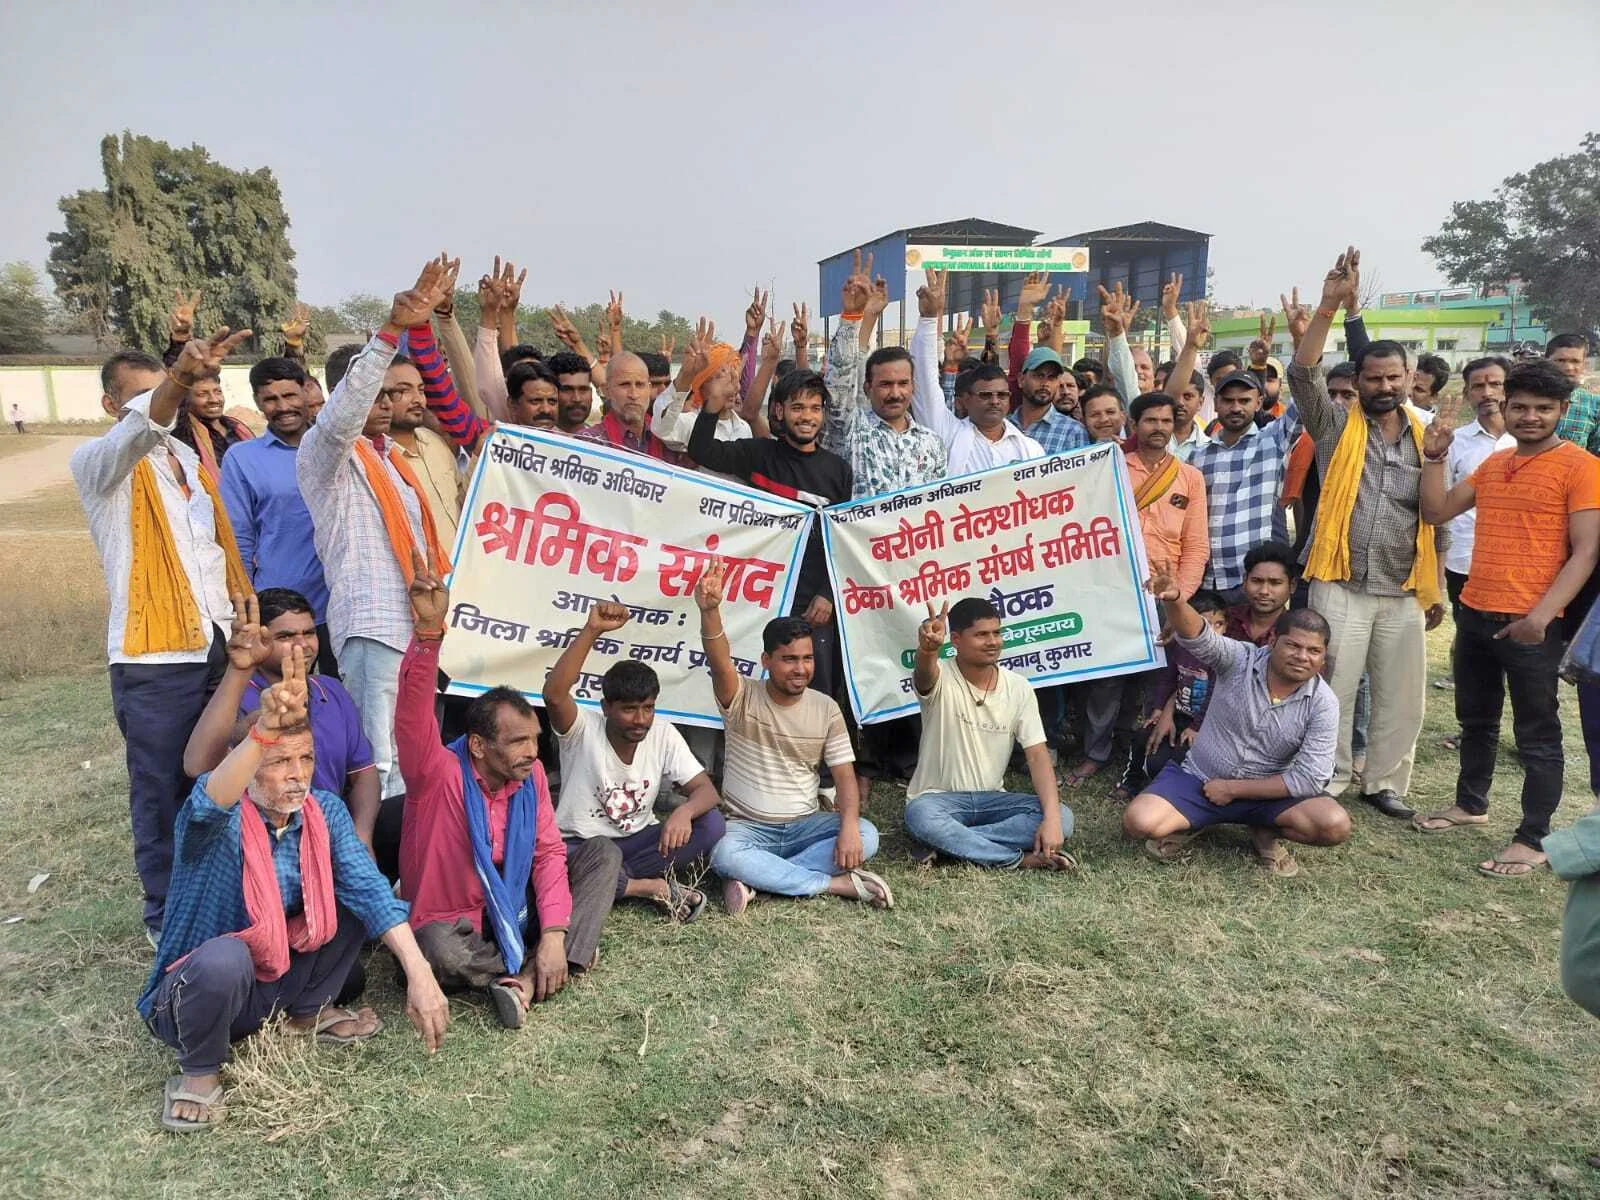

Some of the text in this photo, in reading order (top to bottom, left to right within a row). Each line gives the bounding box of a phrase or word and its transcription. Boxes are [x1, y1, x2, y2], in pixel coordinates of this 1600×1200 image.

[489, 443, 547, 474] संगठित
[550, 458, 602, 486] श्रमिक
[602, 469, 667, 503] अधिकार
[699, 496, 726, 520] शत
[880, 493, 923, 515] श्रमिक
[927, 479, 982, 503] अधिकार
[1013, 466, 1036, 482] शत
[1039, 455, 1085, 478] प्रतिशत
[475, 491, 786, 610] श्रमिक संाद
[869, 486, 1076, 562] बरौनी तेलशोधक
[842, 516, 1121, 615] ठेका श्रमिक संघर्ष समिति
[451, 603, 530, 644] जिला
[536, 628, 624, 656] श्रिक
[629, 641, 686, 665] कार्य
[1001, 617, 1076, 643] बेगूसराय
[1045, 642, 1093, 670] कुमार
